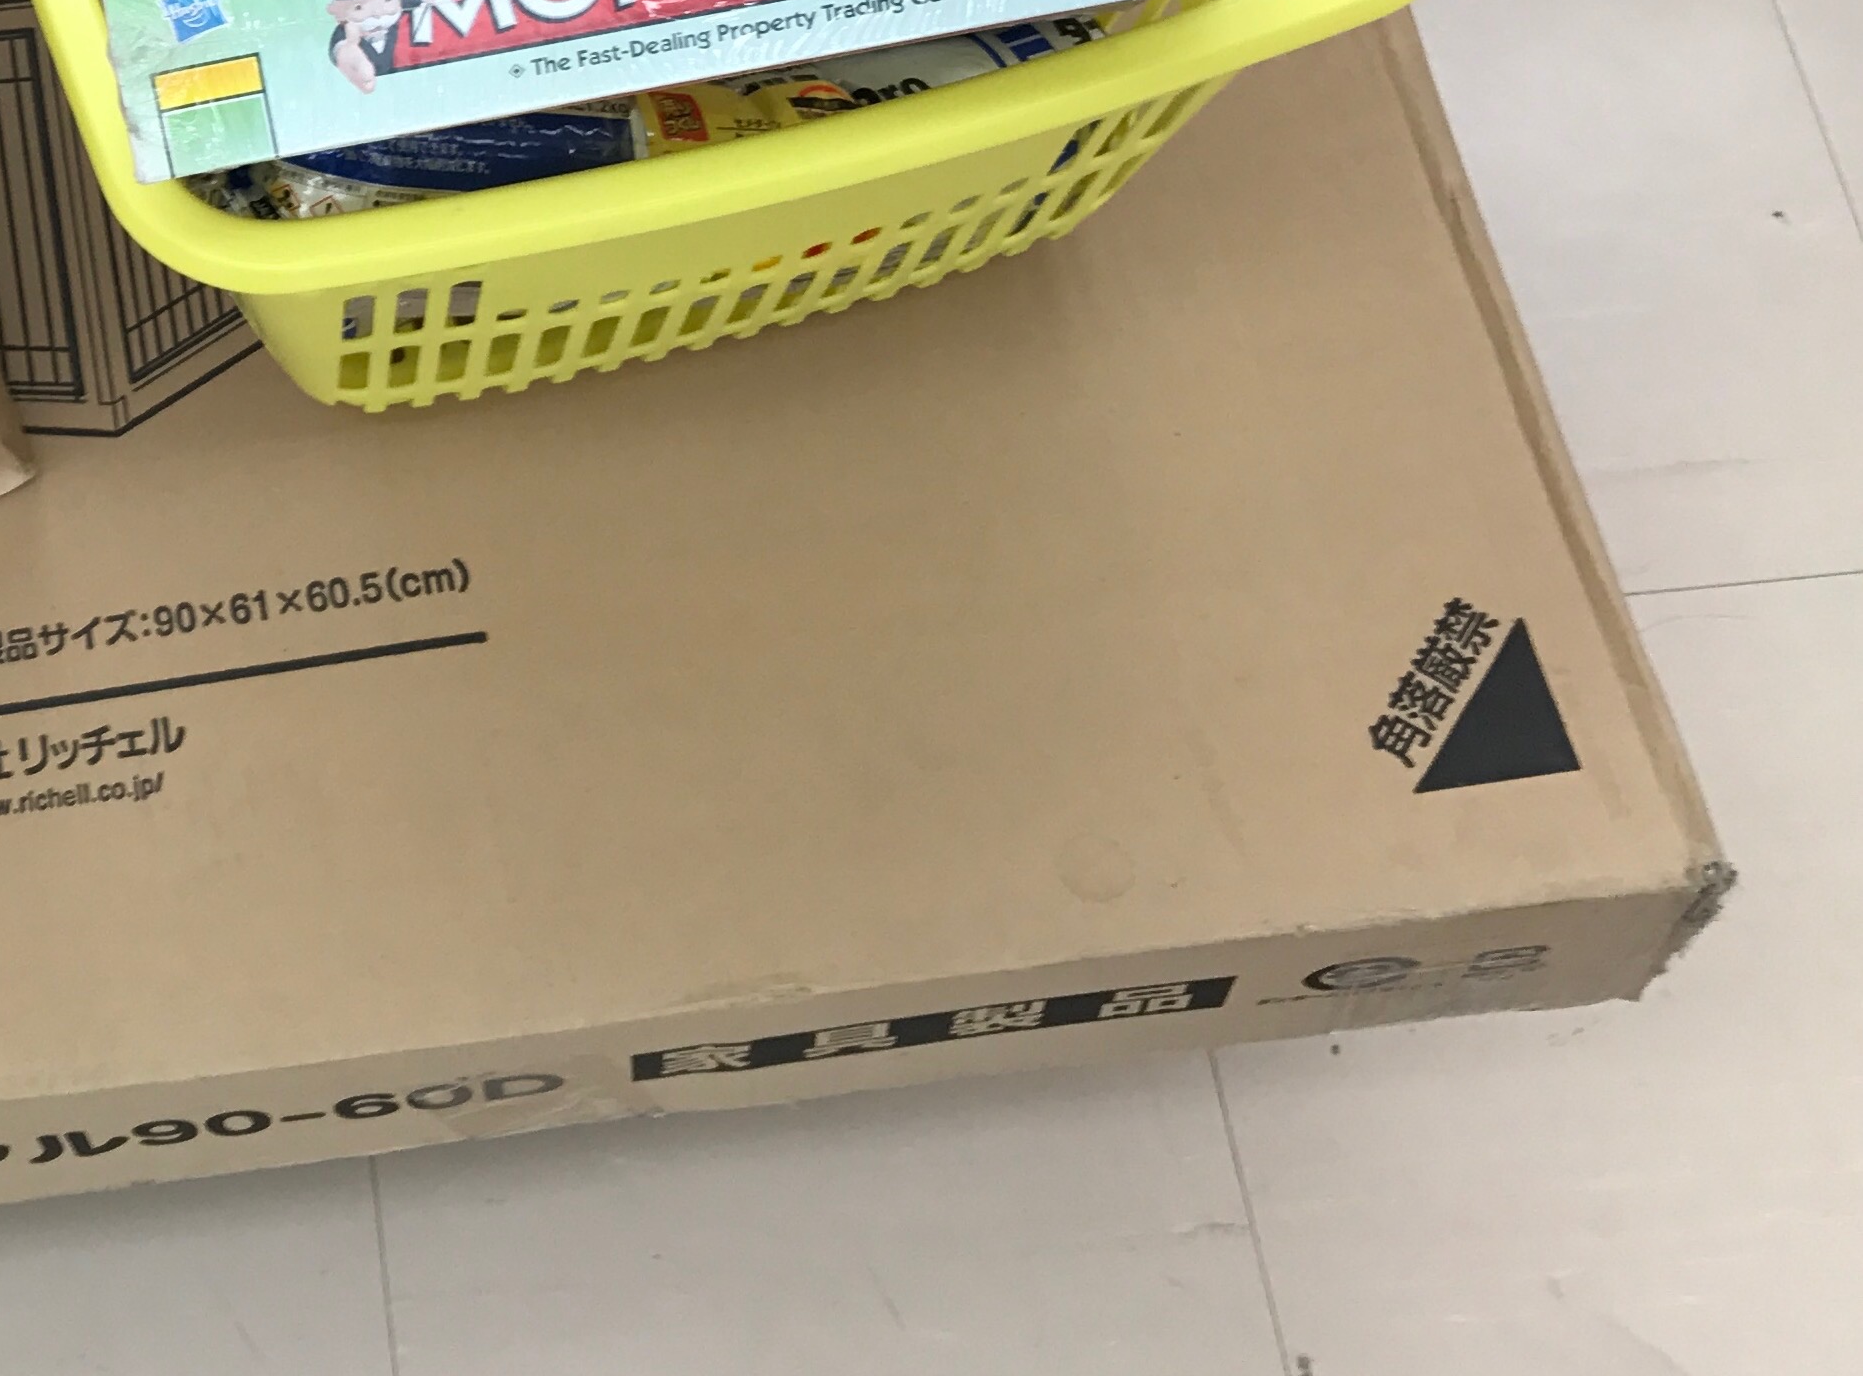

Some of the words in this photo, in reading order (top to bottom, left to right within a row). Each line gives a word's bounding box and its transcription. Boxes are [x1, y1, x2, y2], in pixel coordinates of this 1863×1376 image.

[531, 50, 571, 78] The
[576, 22, 712, 68] Fast-Dealing
[716, 7, 817, 48] Property
